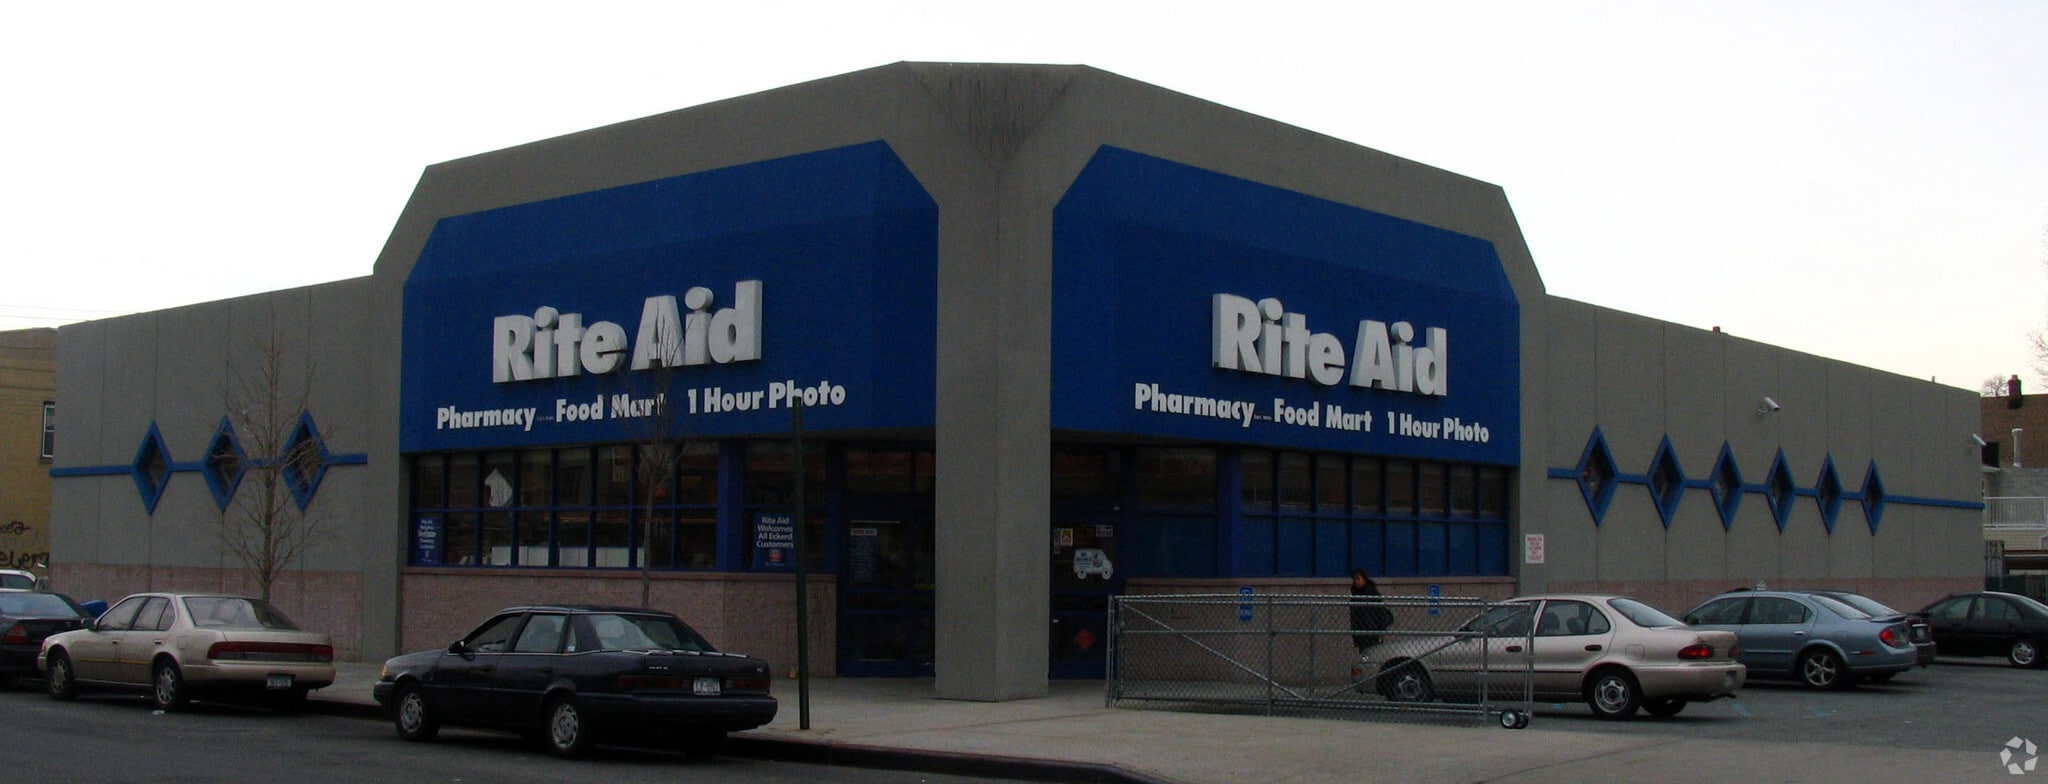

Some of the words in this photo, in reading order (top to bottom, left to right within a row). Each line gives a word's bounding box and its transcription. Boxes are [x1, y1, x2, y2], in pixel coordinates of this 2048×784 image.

[492, 305, 628, 383] Rite
[631, 279, 763, 371] Aid
[1212, 293, 1346, 386] Rite
[1349, 319, 1447, 396] Aid
[437, 405, 537, 431] Pharmacy
[556, 394, 604, 423] Food
[688, 388, 697, 415] 1
[704, 387, 764, 413] Hour
[769, 380, 847, 409] Photo
[1134, 383, 1256, 428] Pharmacy
[1274, 398, 1320, 427] Food
[1326, 404, 1373, 433] Mart
[1387, 410, 1395, 435] 1
[1400, 412, 1441, 439] Hour
[1443, 417, 1490, 444] Photo
[756, 540, 794, 548] Customers
[761, 516, 776, 524] Rite
[777, 516, 790, 525] Aid
